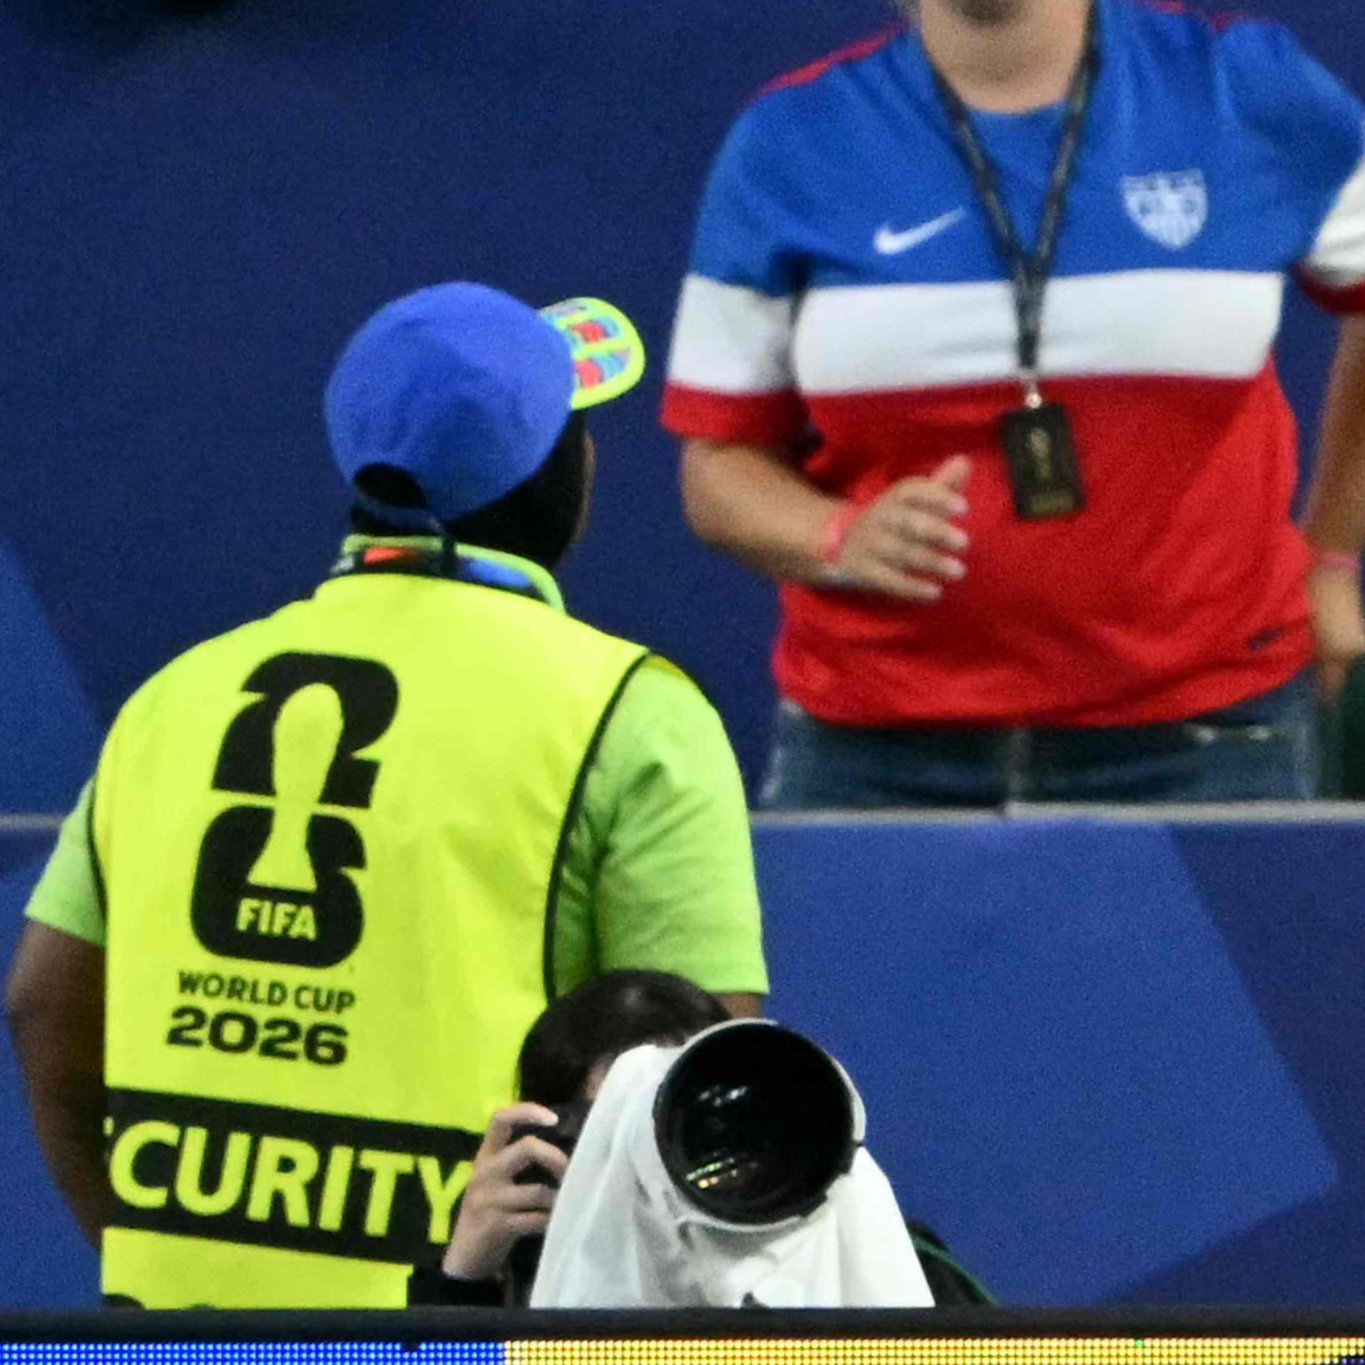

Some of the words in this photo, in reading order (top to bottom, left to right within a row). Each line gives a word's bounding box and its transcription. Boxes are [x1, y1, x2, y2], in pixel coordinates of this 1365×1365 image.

[236, 897, 317, 941] FIFA
[177, 970, 289, 1007] WORLD
[293, 984, 357, 1015] CUP
[166, 1005, 349, 1067] 2026
[103, 1117, 475, 1245] CURITY
